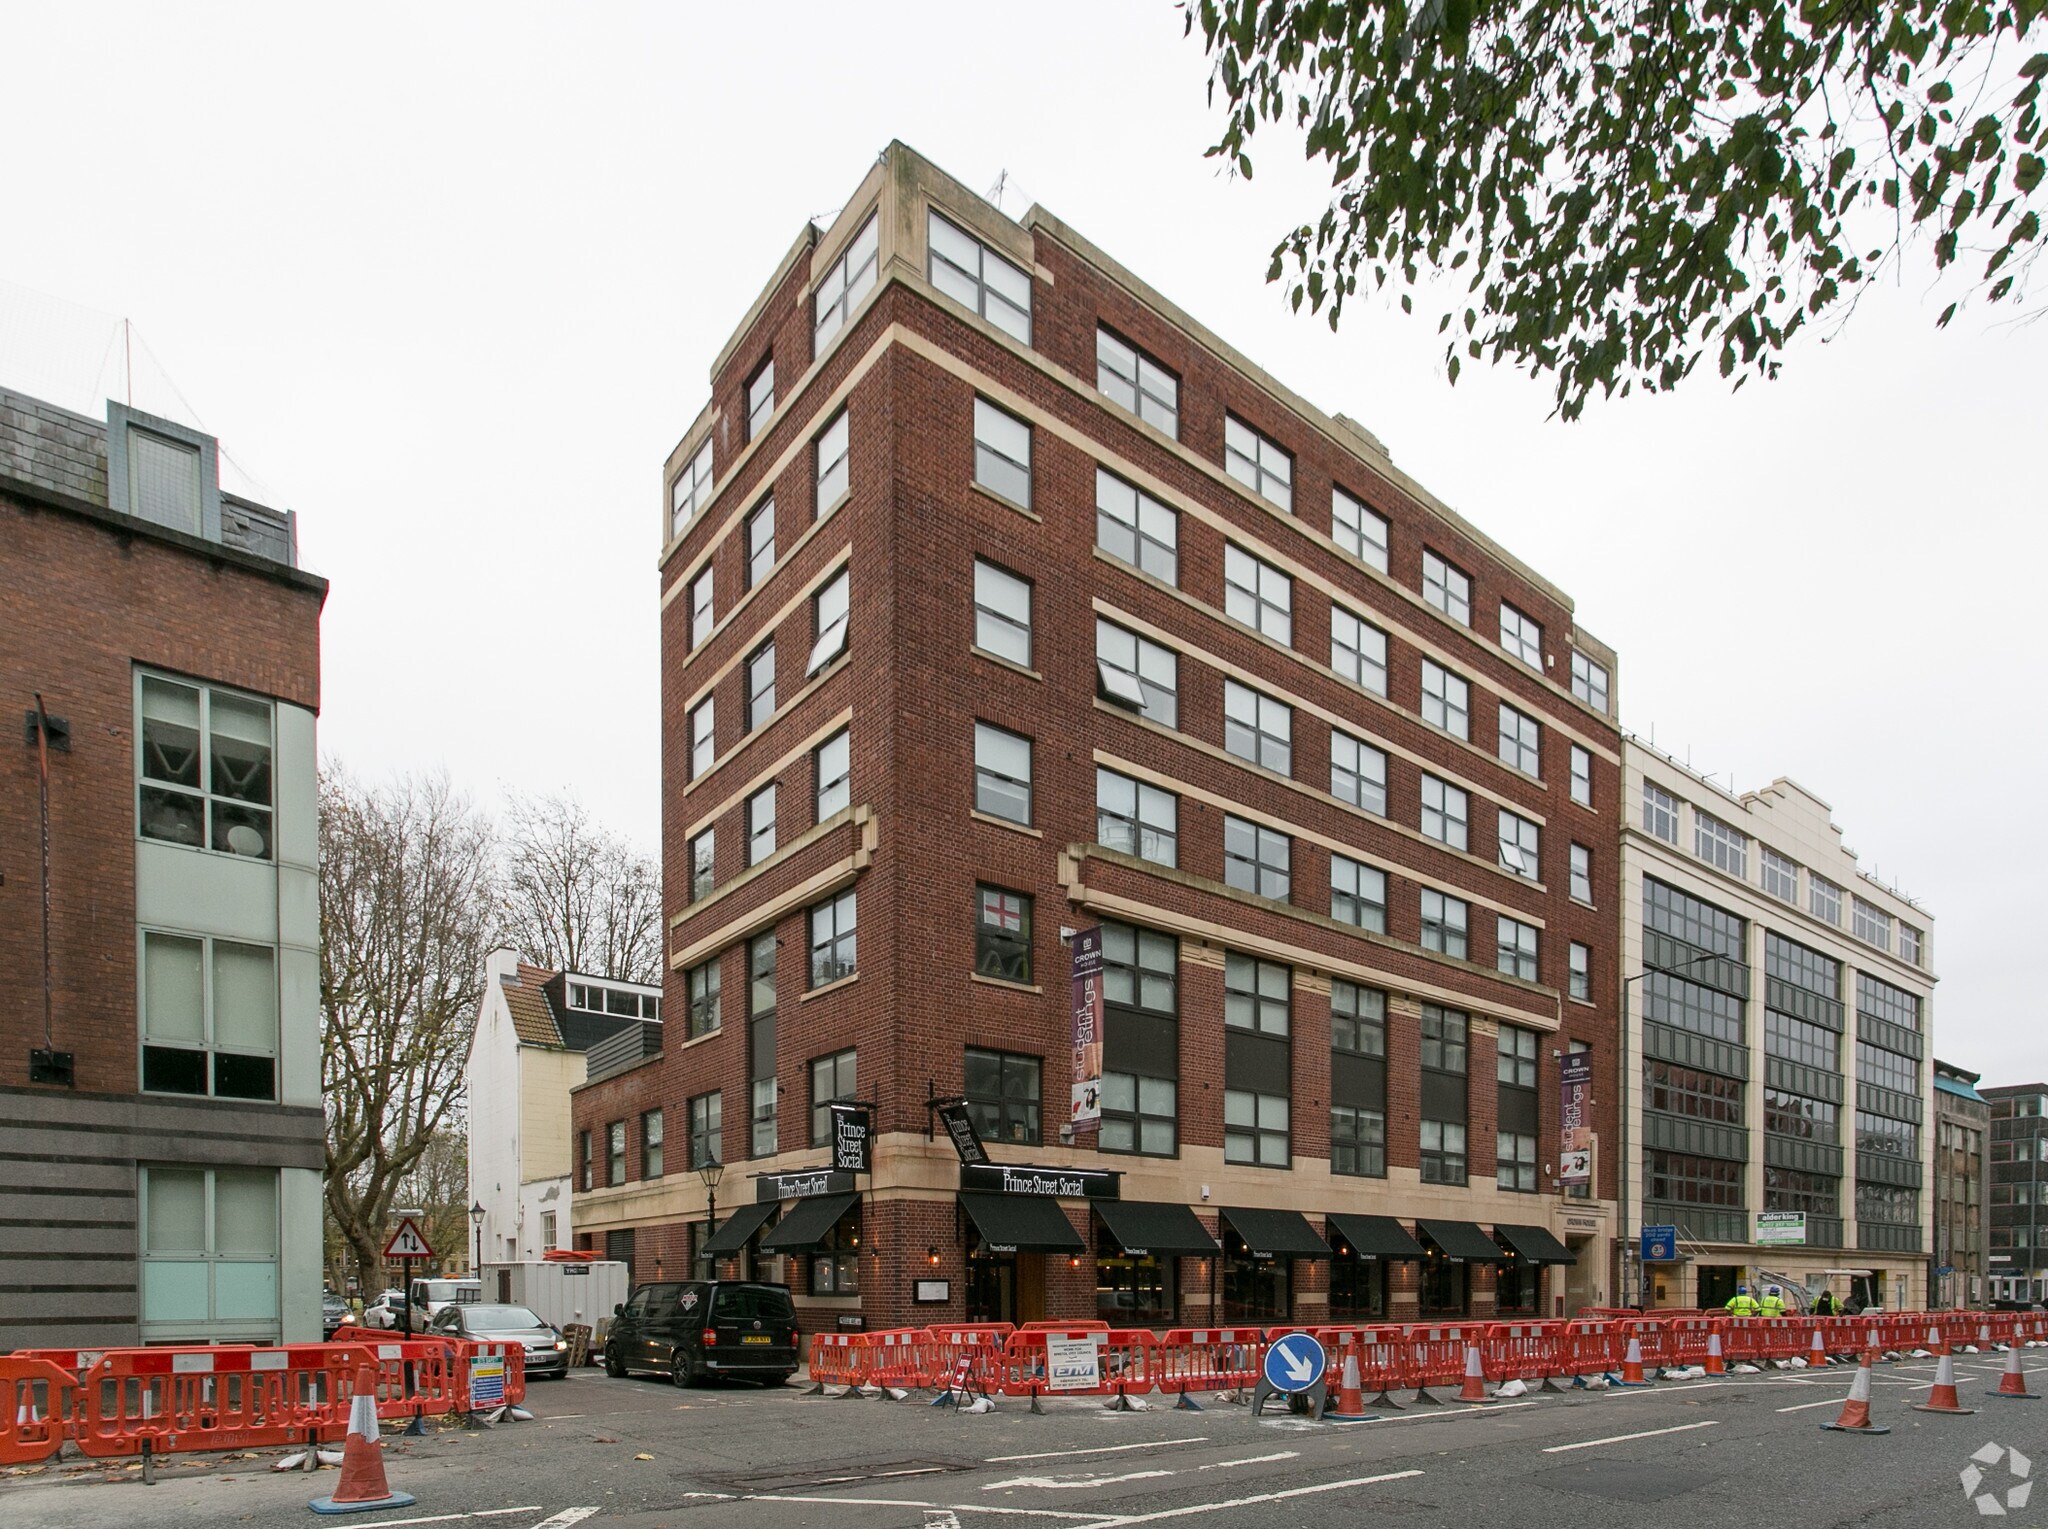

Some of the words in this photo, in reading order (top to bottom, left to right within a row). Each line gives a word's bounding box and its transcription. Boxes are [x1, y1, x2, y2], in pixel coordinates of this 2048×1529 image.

[1074, 949, 1102, 964] CROWN
[1075, 1008, 1086, 1081] student
[1563, 1066, 1589, 1075] CROWN
[837, 1119, 866, 1139] Prince
[949, 1118, 971, 1134] Prince
[1563, 1103, 1573, 1152] student
[837, 1134, 863, 1153] Street
[953, 1132, 975, 1147] Street
[838, 1151, 865, 1169] Social
[960, 1144, 982, 1161] Social
[778, 1182, 796, 1199] Prince
[795, 1179, 811, 1197] Street
[811, 1175, 829, 1195] Social
[1003, 1173, 1033, 1193] Prince
[1033, 1175, 1059, 1195] Street
[1059, 1177, 1085, 1197] Social
[1762, 1213, 1781, 1221] alder
[1782, 1212, 1799, 1222] king
